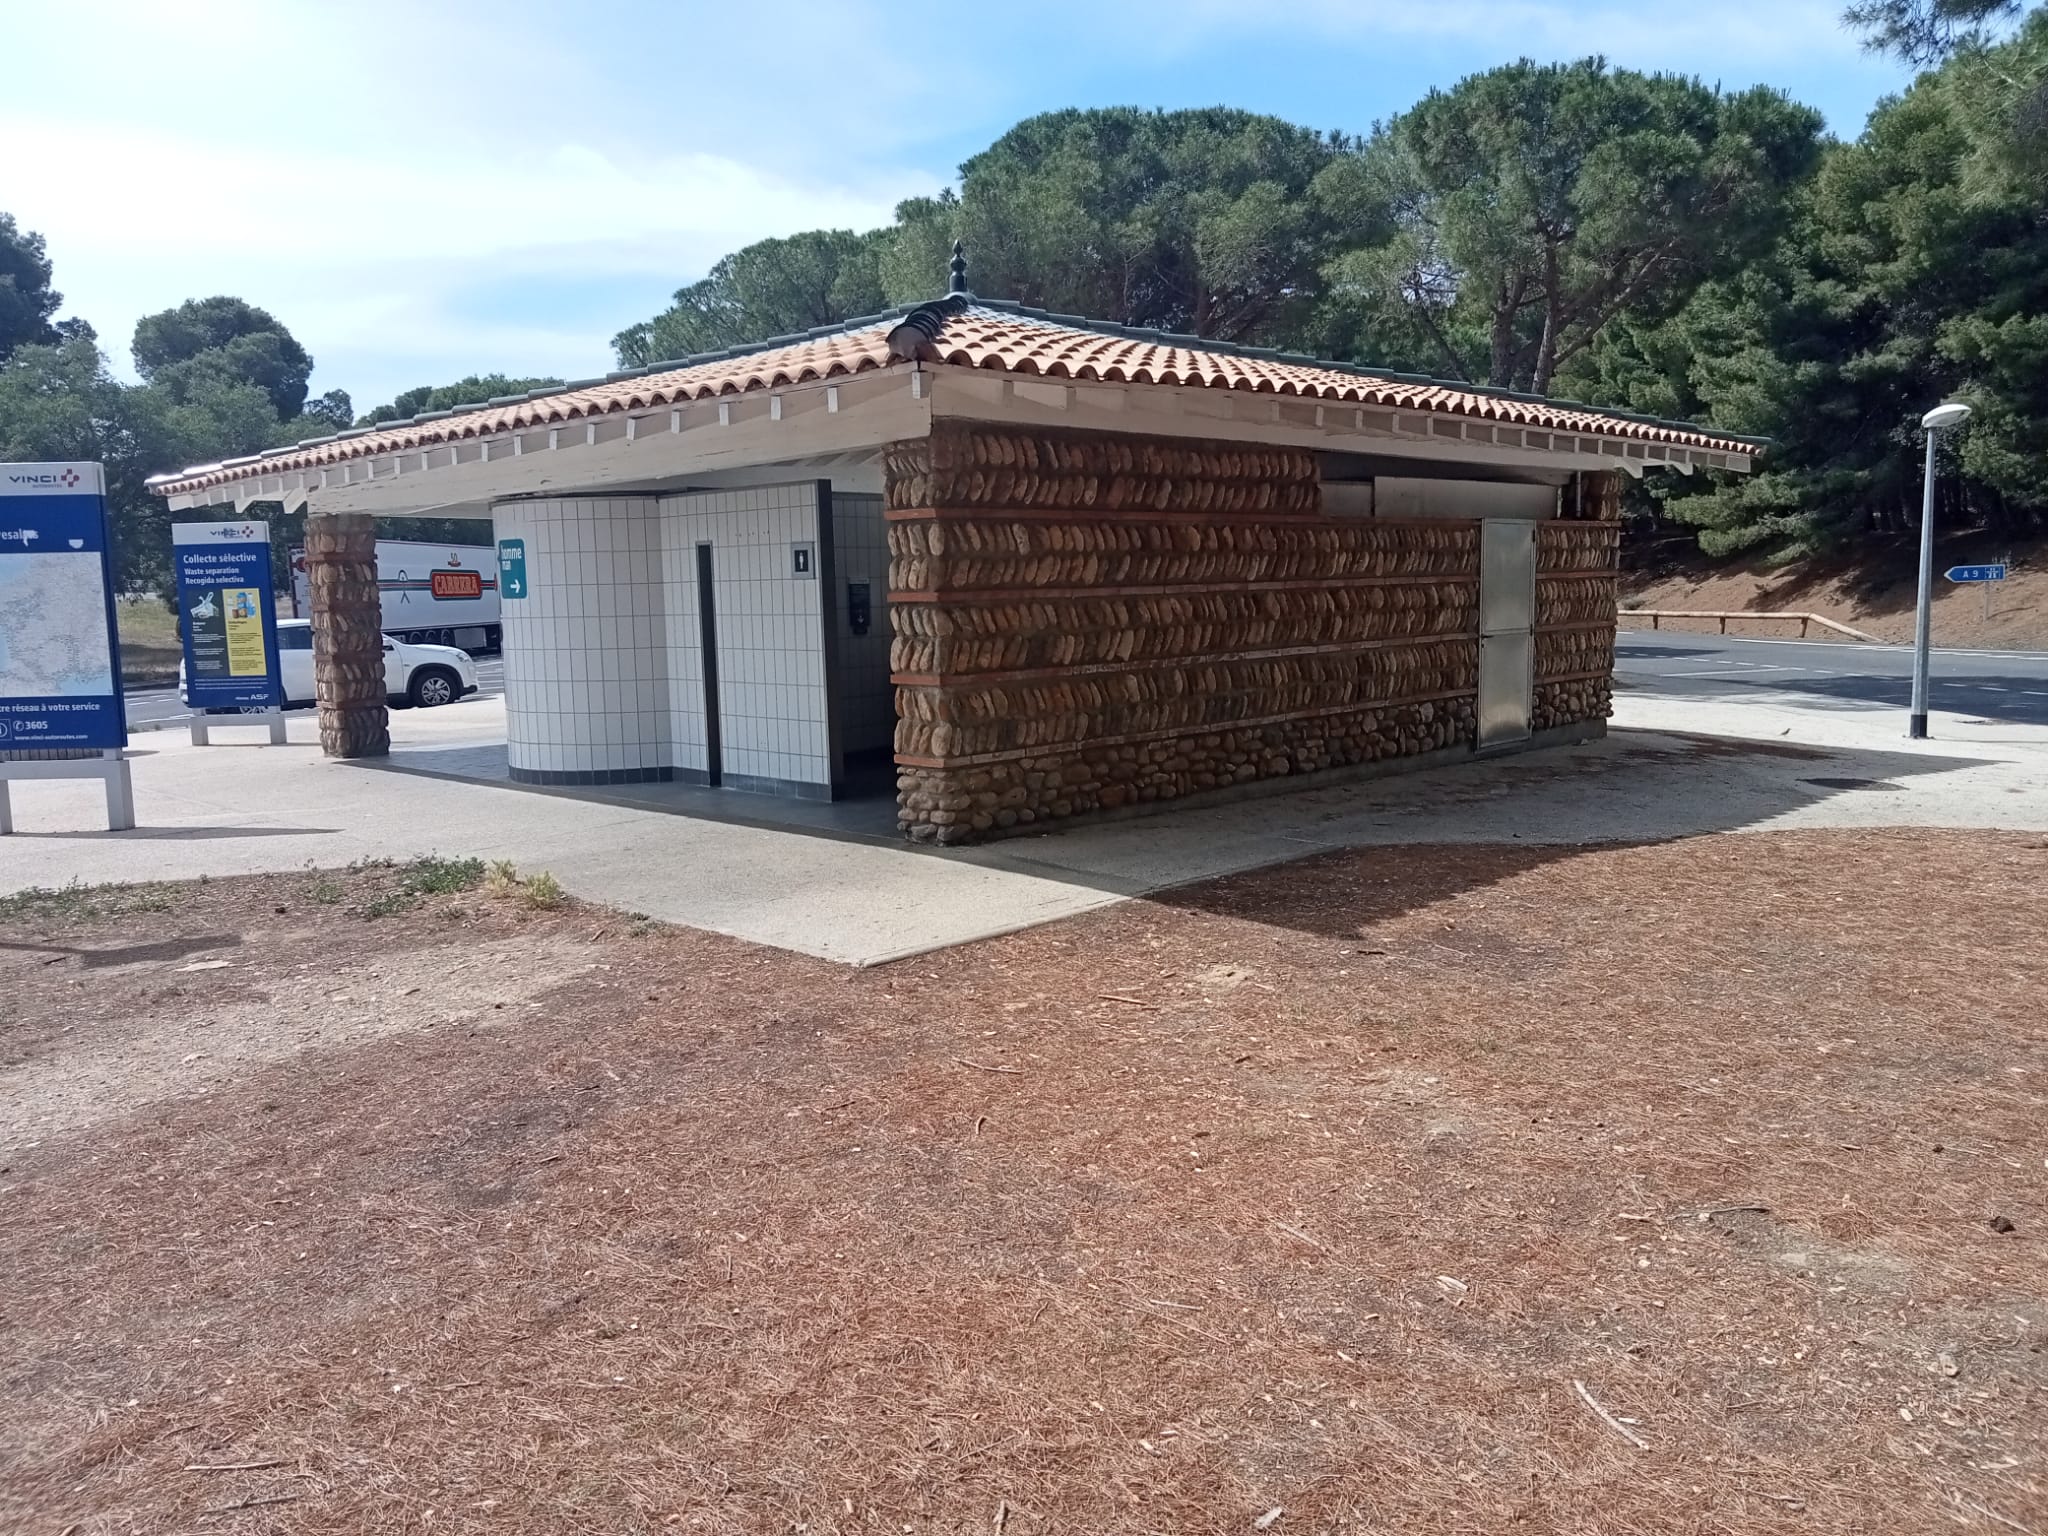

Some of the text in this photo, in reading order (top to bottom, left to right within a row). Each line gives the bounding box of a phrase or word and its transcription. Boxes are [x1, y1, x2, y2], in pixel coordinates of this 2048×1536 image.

[9, 475, 57, 483] VINCI
[183, 552, 257, 564] Collecte sélective
[184, 566, 240, 576] Waste separation
[1972, 570, 1979, 578] 9
[185, 576, 215, 585] Recogida
[12, 704, 40, 712] réseau
[41, 703, 47, 711] à
[72, 702, 100, 711] service
[25, 721, 48, 730] 3605
